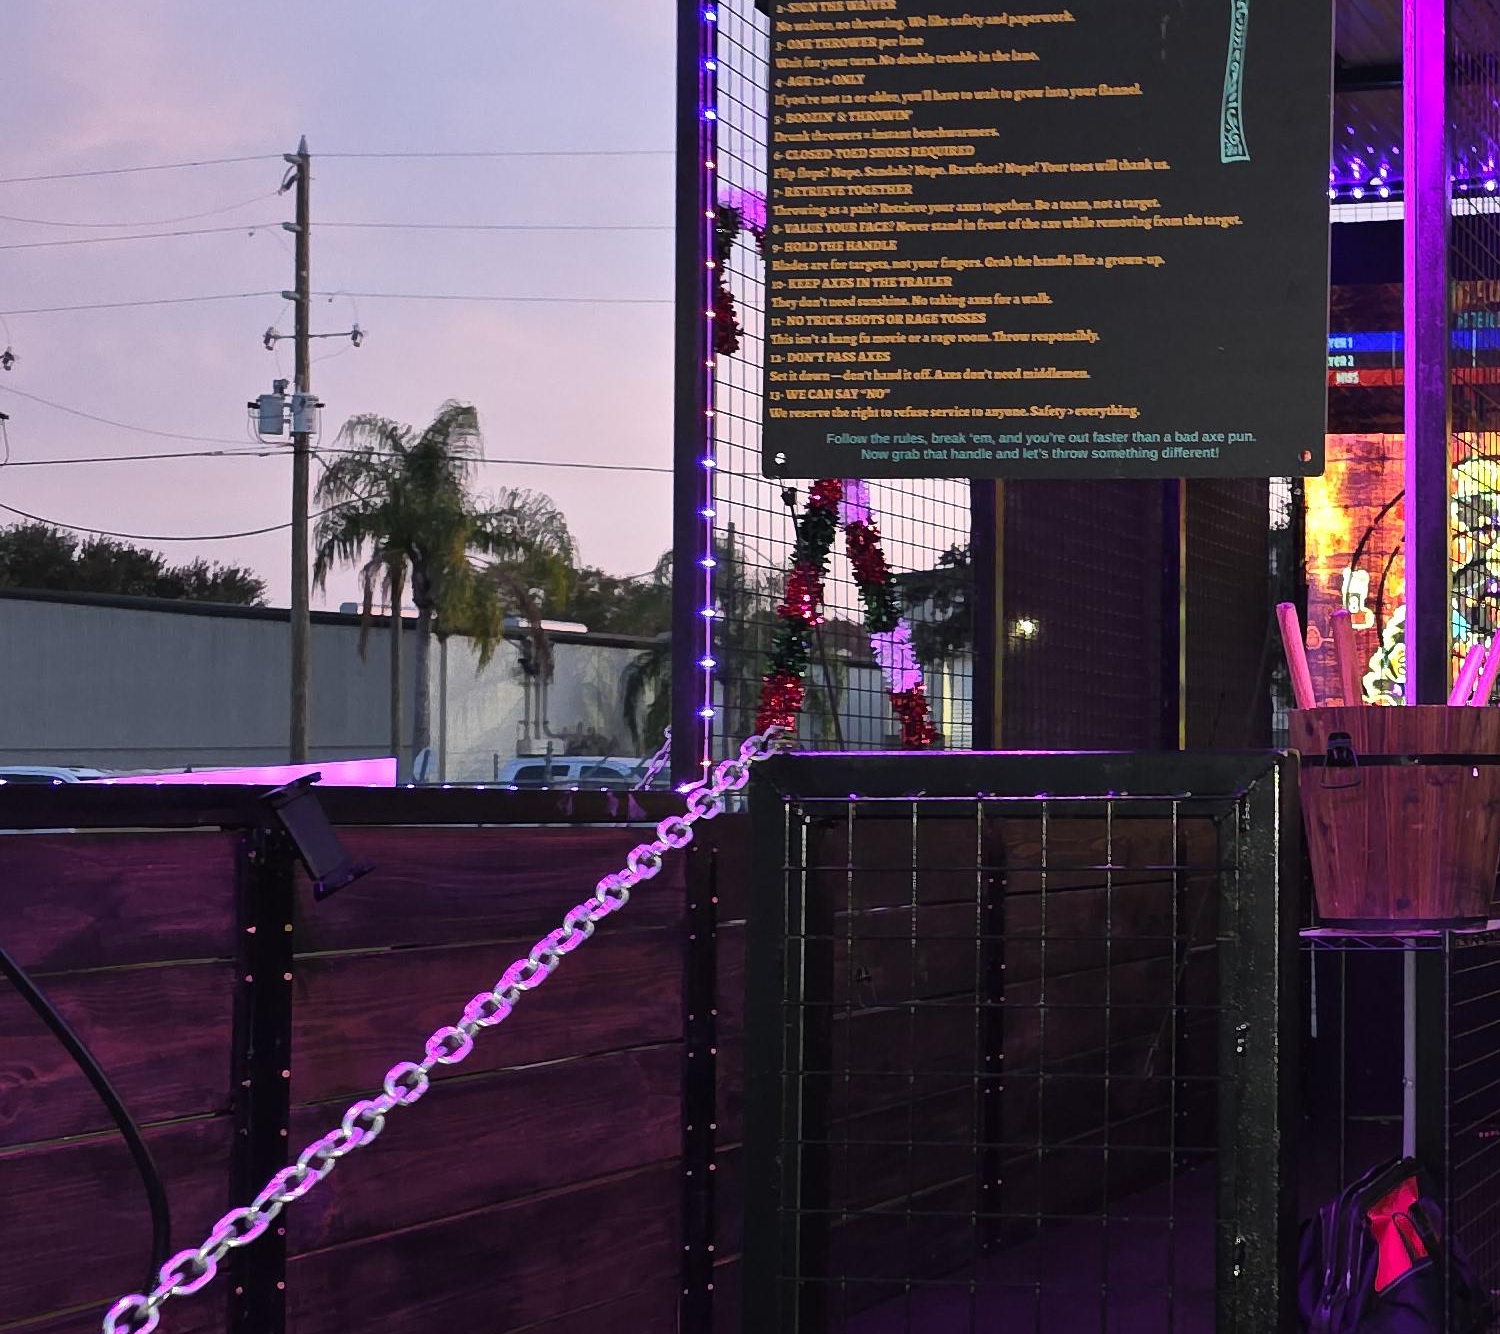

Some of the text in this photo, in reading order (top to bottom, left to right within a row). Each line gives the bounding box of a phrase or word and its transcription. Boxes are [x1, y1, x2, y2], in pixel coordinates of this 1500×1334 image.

[786, 316, 804, 325] NO
[805, 315, 845, 325] TRICK
[845, 314, 885, 325] SHOTS
[886, 314, 904, 324] OR
[905, 314, 938, 324] RAGE
[939, 313, 986, 323] TOSSES
[826, 433, 868, 444] Follow
[870, 433, 890, 444] the
[893, 433, 928, 445] rules,
[931, 432, 966, 443] break
[998, 432, 1022, 443] and
[1025, 432, 1065, 445] you're
[1068, 433, 1089, 443] out
[1093, 431, 1128, 443] faster
[1132, 431, 1160, 442] than
[1163, 434, 1171, 442] a
[1175, 431, 1198, 442] bad
[1202, 433, 1224, 442] axe
[1228, 433, 1256, 444] pun.
[861, 447, 1219, 462] Now grab that handle and let's throw something different!
